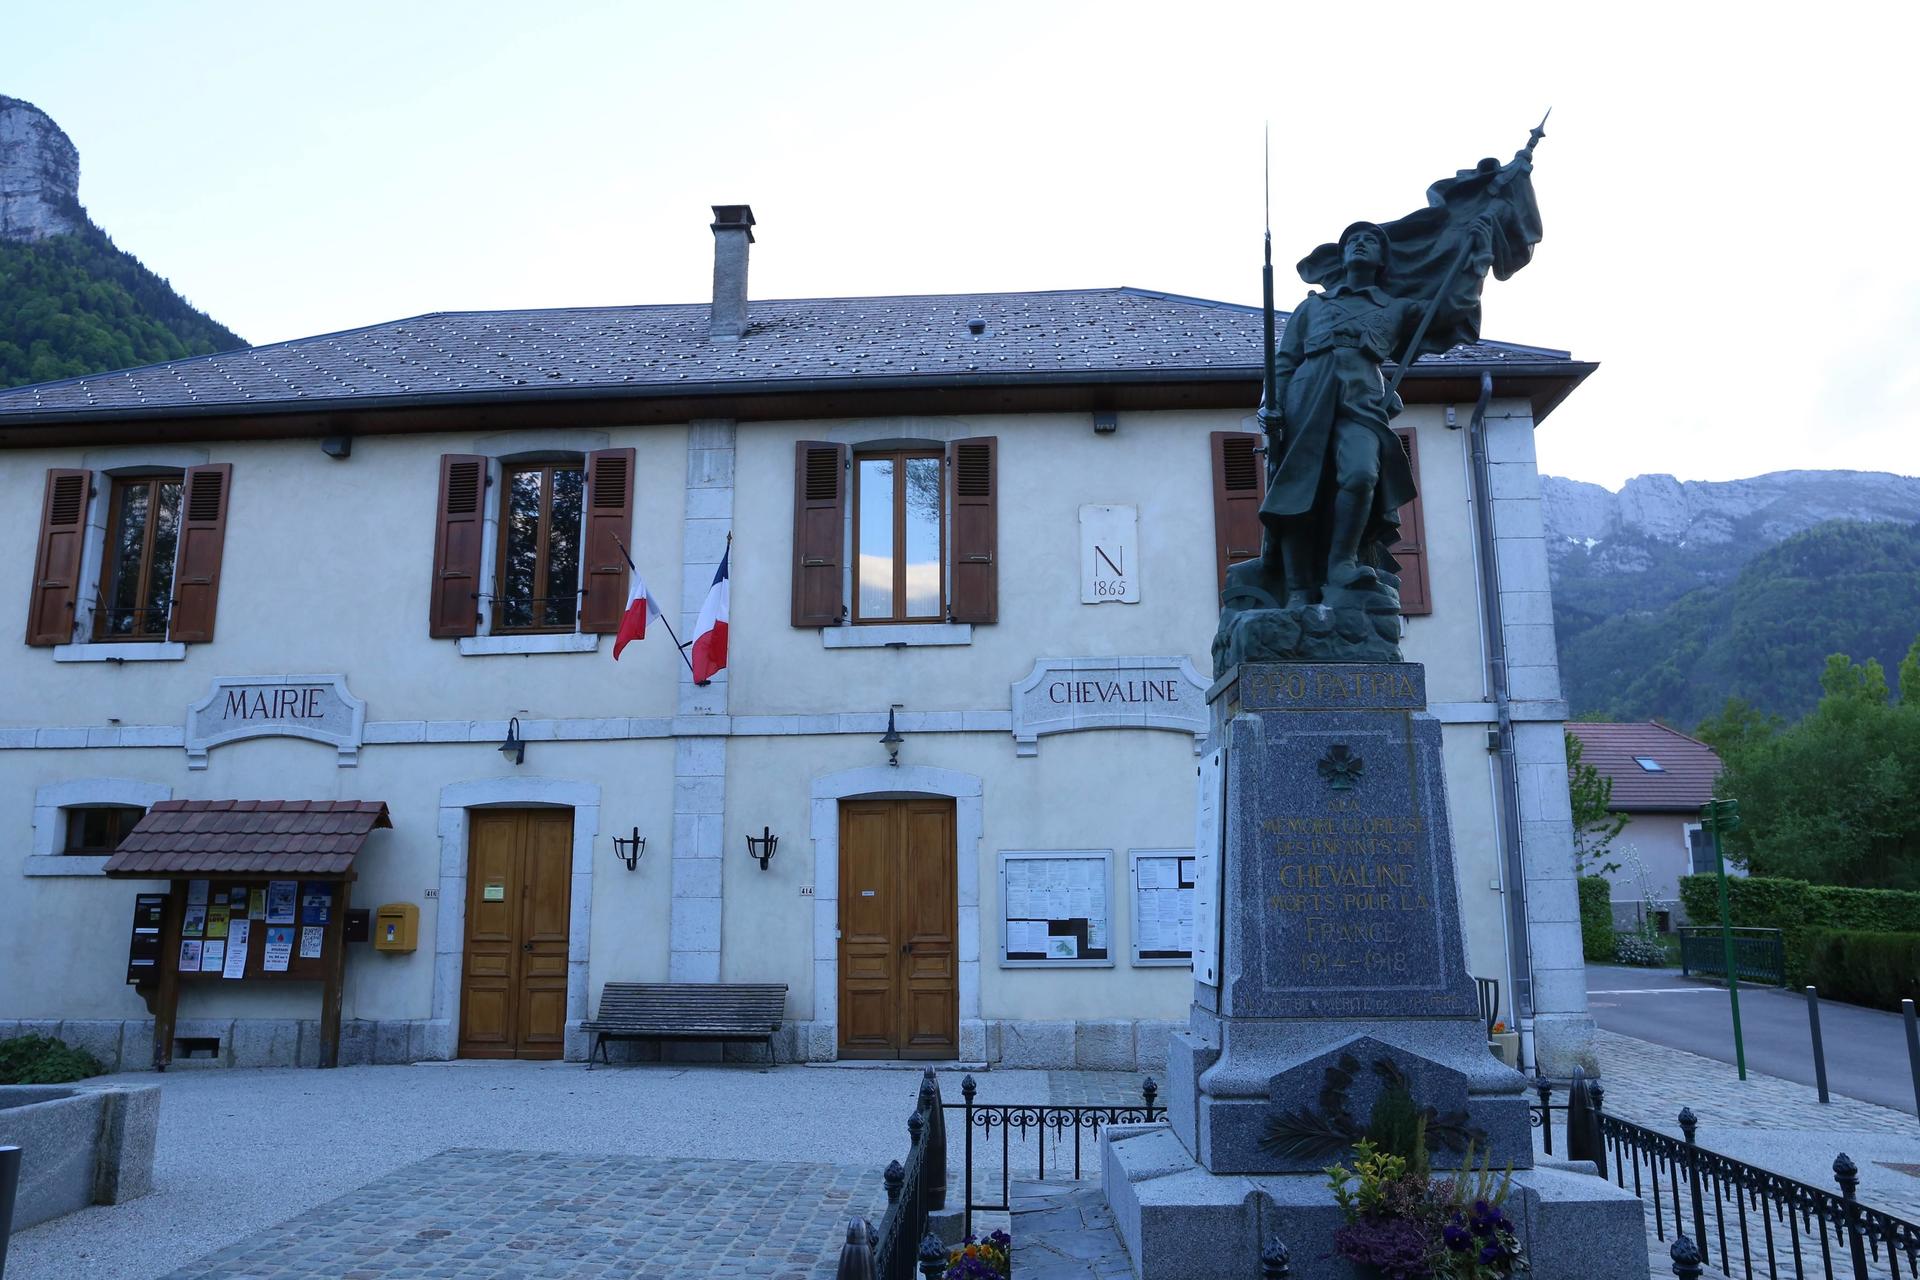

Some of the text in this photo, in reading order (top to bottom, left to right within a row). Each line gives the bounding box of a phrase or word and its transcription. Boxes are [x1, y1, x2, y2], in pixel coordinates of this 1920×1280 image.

[1094, 545, 1123, 577] N
[1093, 580, 1127, 597] 1865
[1049, 681, 1179, 704] CHEVALINE
[1251, 671, 1419, 699] PRO PATRIA
[223, 688, 325, 720] MAIRIE
[1280, 864, 1414, 888] CHEVALINE
[1270, 893, 1428, 912] MORTS POUR LA
[1306, 916, 1398, 944] FRANCE
